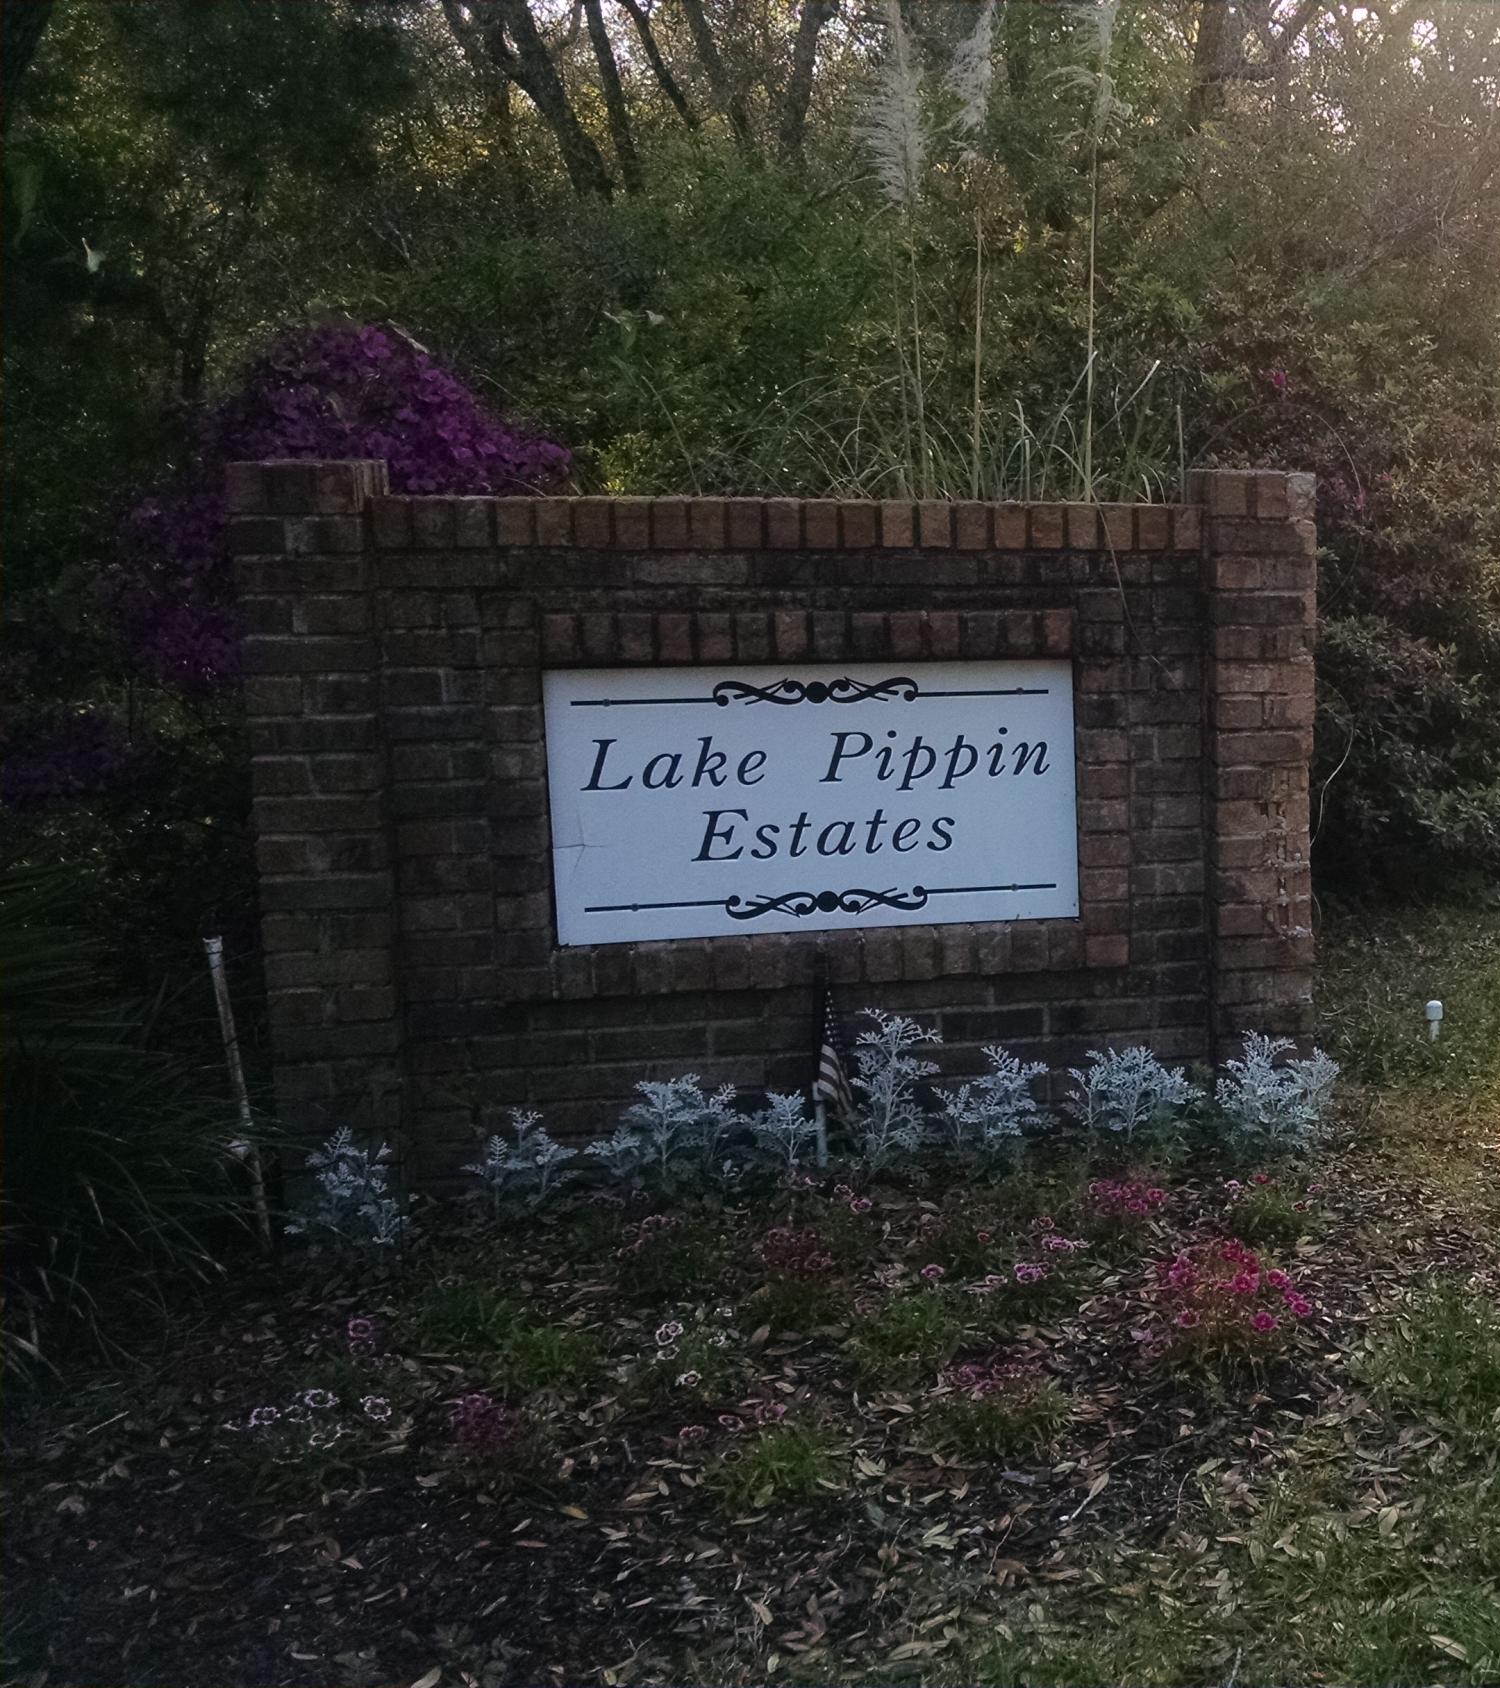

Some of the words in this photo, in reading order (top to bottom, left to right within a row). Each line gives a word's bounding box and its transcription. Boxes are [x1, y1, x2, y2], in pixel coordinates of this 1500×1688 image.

[580, 735, 768, 791] Lake
[818, 726, 1051, 792] Pippin
[690, 808, 956, 863] Estates
